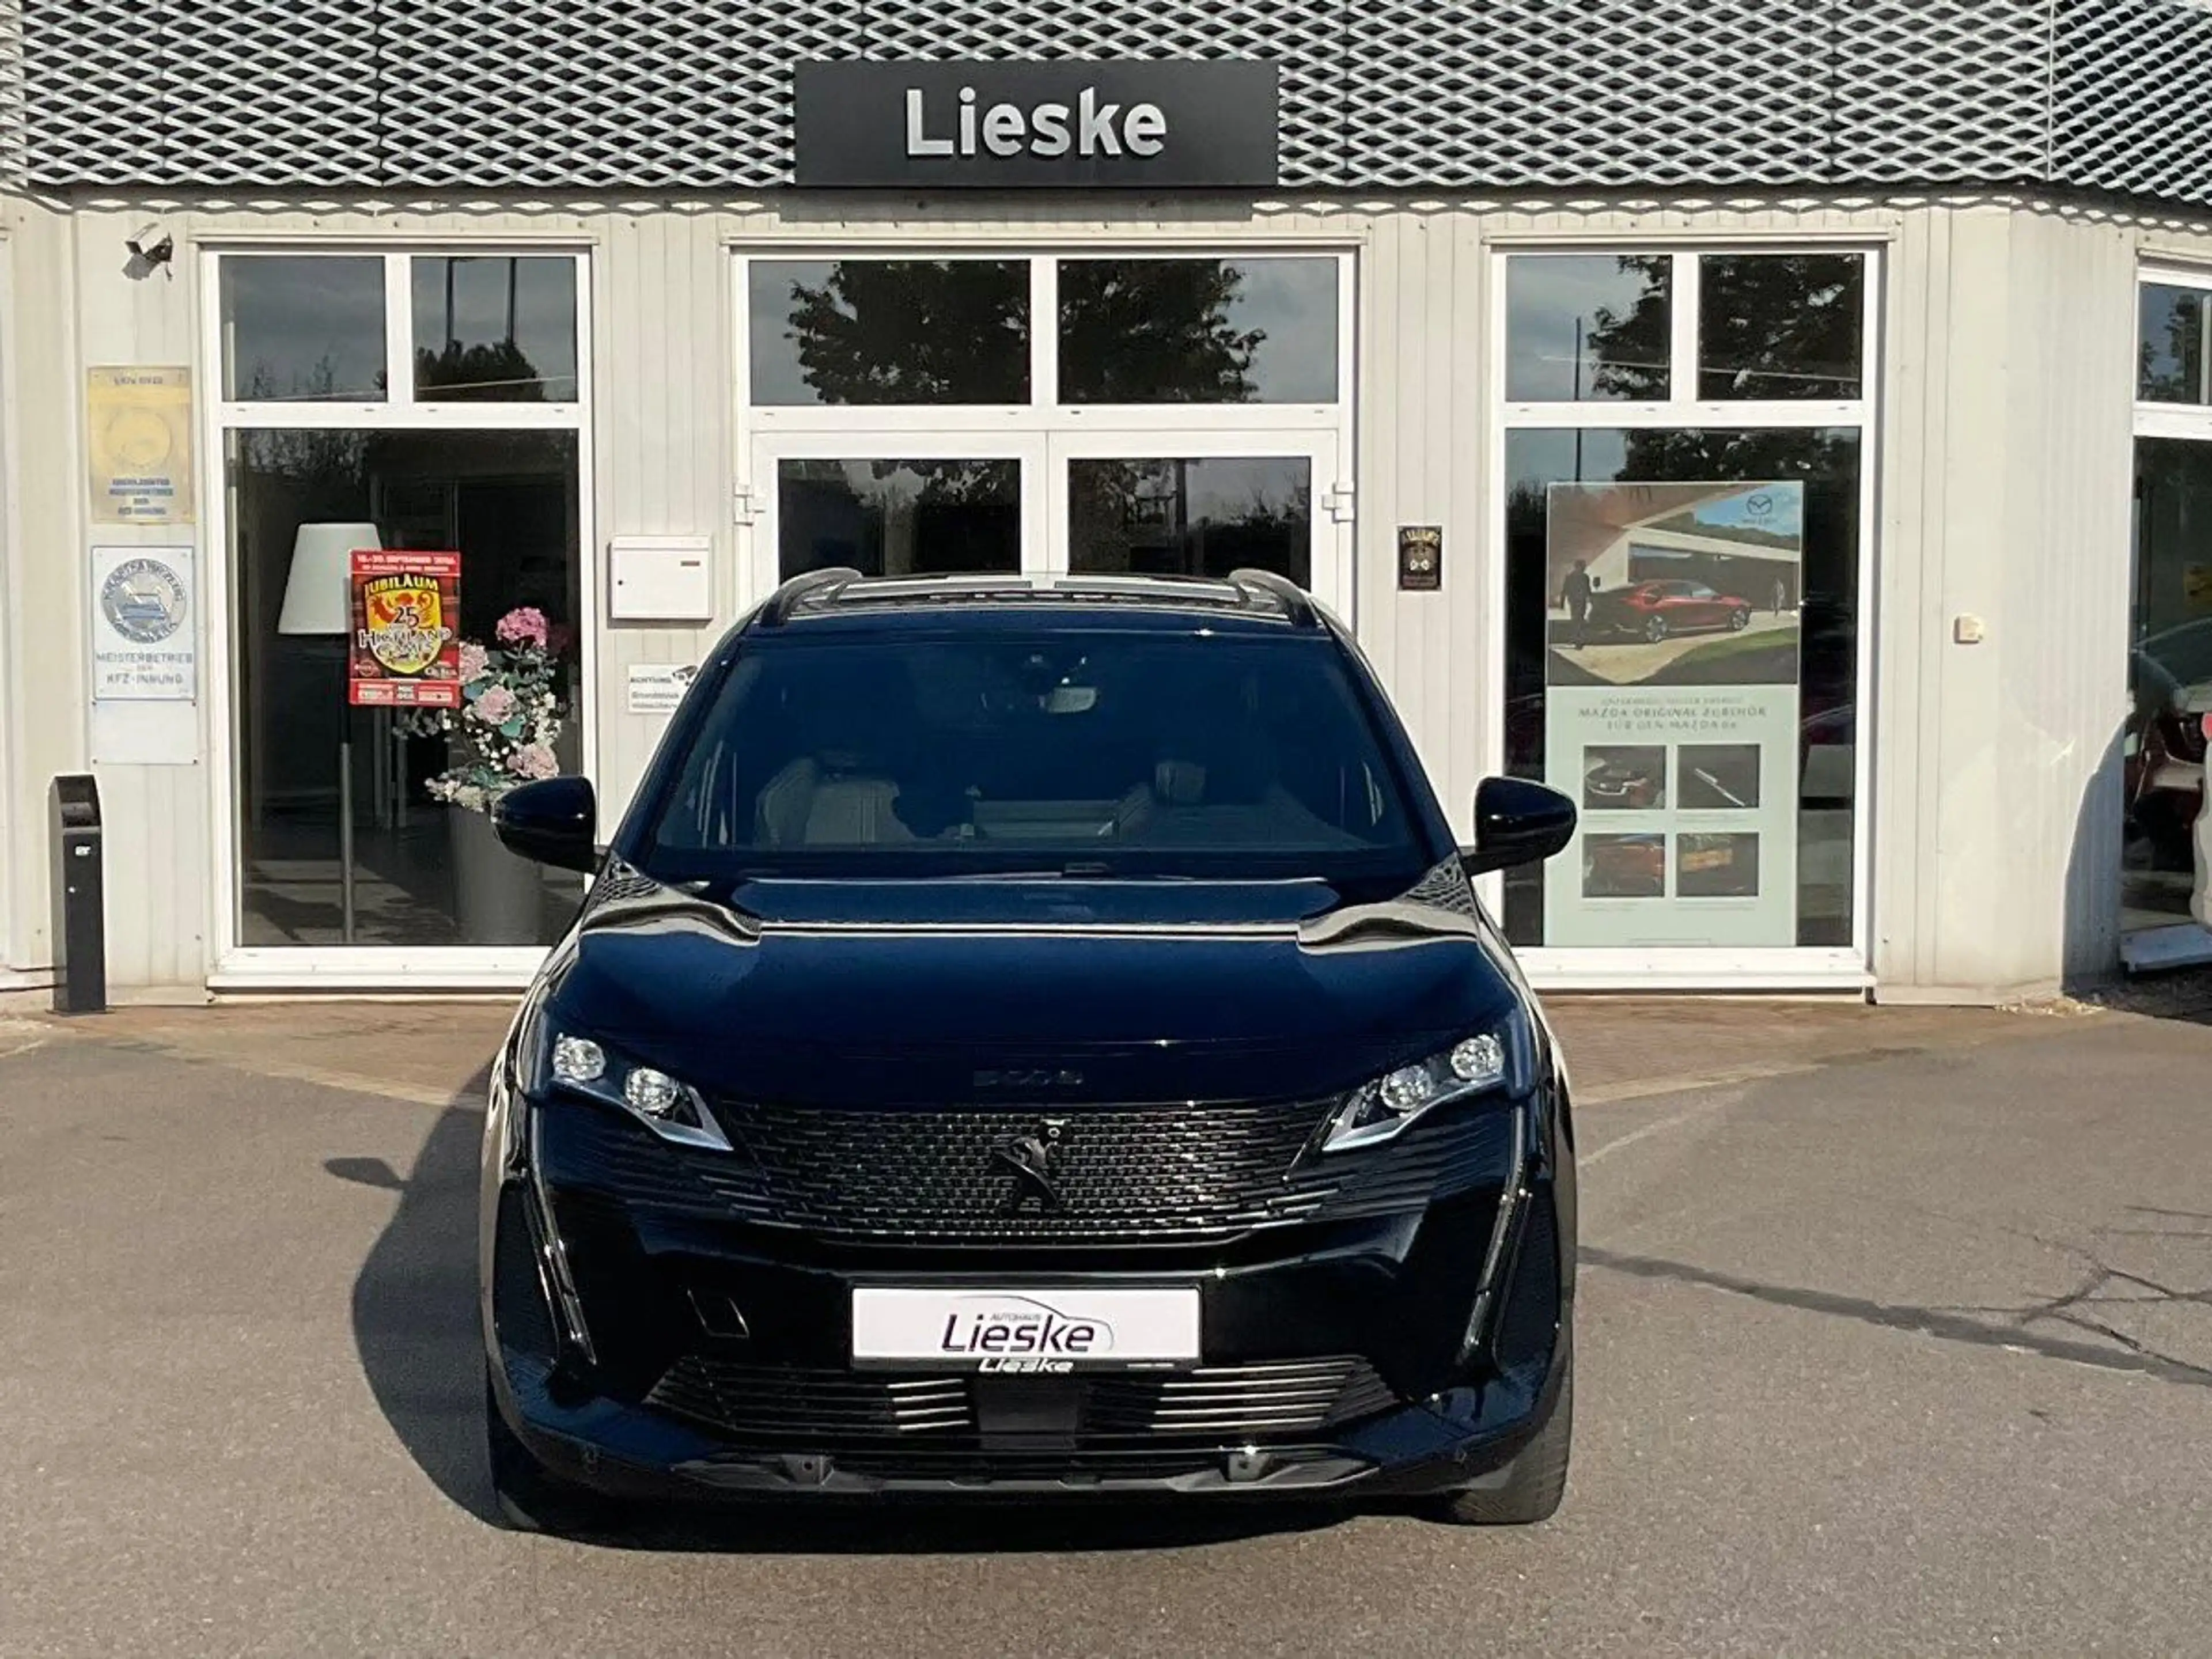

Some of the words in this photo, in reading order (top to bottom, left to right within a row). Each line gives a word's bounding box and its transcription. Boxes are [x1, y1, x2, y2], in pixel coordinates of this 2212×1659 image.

[906, 85, 1167, 157] Lieske
[364, 573, 438, 598] JUBILÄUM
[394, 605, 419, 628] 25
[96, 652, 193, 663] MEISTERBETRIEB
[1578, 707, 1628, 718] MAZDA
[1633, 707, 1697, 718] ORIGINAL
[990, 1313, 1041, 1322] AUTOHAUS
[941, 1313, 1095, 1353] Lieske
[978, 1355, 1074, 1373] Lieske
